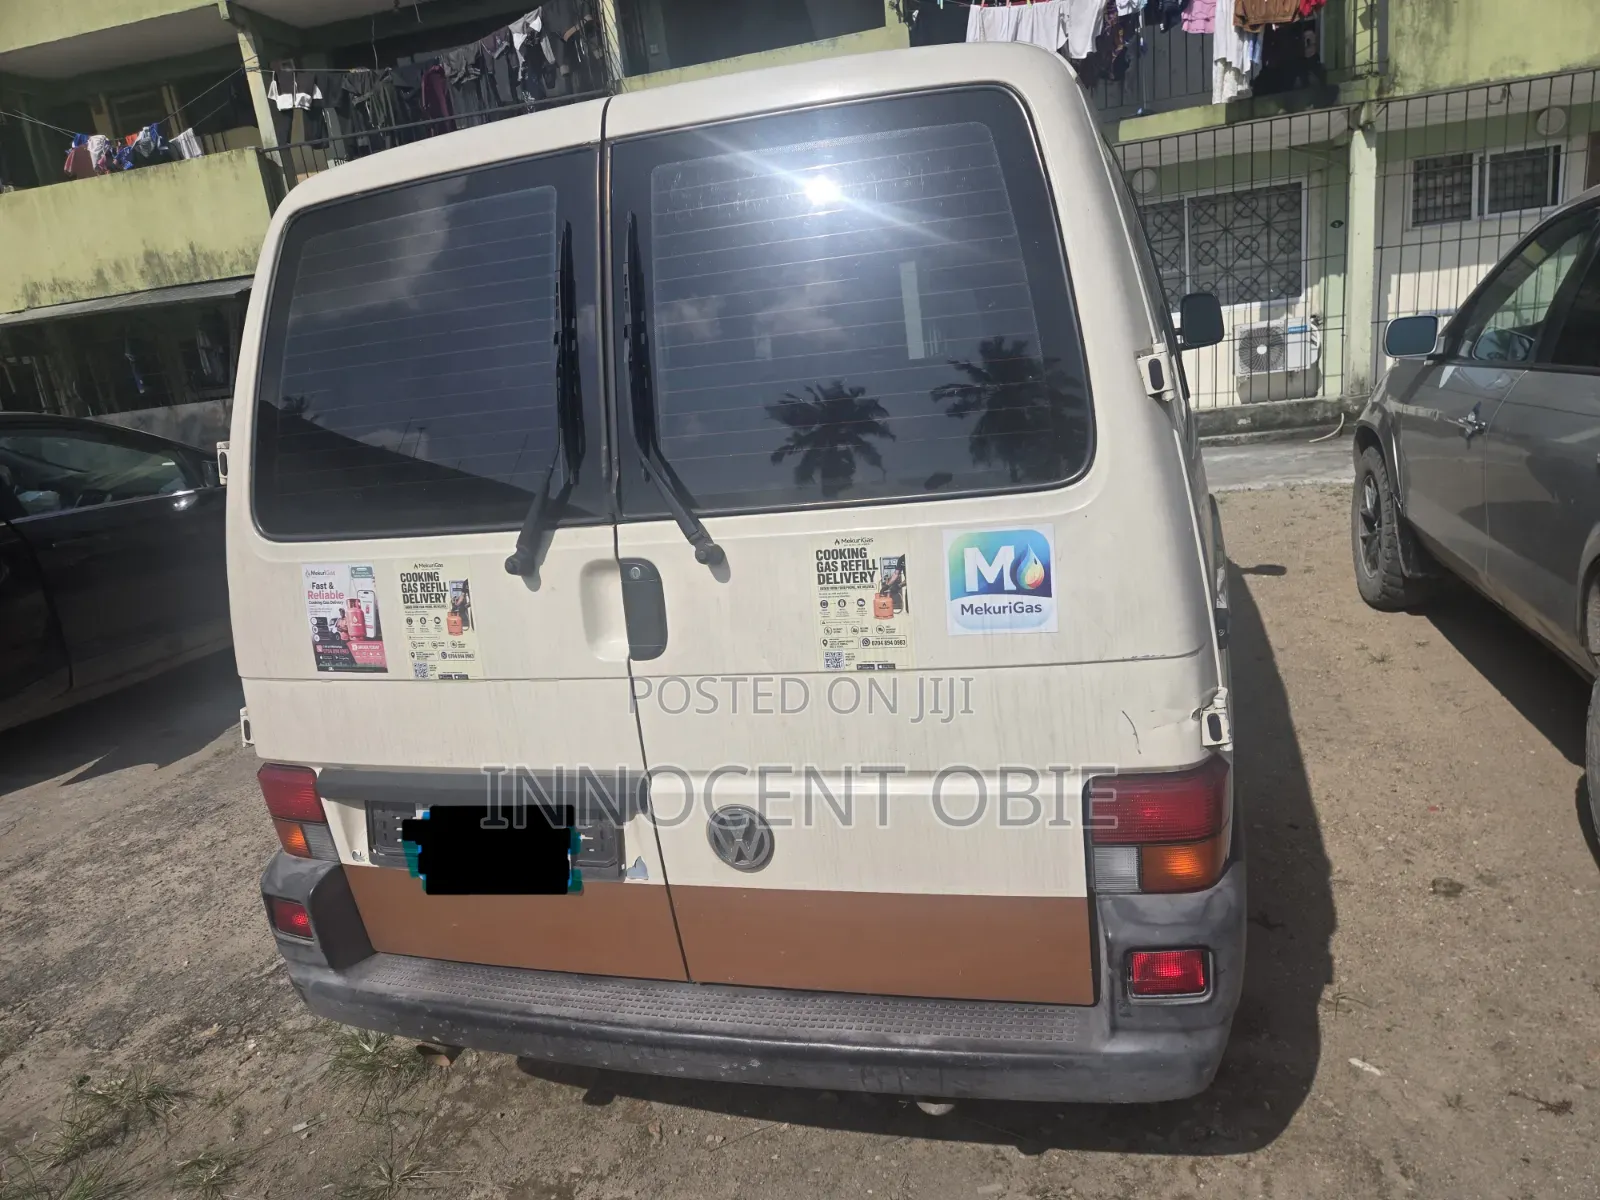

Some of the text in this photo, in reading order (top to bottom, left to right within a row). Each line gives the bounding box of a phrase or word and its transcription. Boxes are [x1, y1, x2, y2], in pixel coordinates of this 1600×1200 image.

[816, 547, 867, 561] COOKING
[816, 559, 878, 573] GAS REFILL
[400, 571, 439, 583] COOKING
[817, 571, 876, 585] DELIVERY
[311, 582, 334, 590] Fast &
[401, 582, 449, 593] GAS REFILL
[307, 590, 344, 600] Reliable
[402, 593, 447, 604] DELIVERY
[961, 601, 1042, 616] MekuriGas
